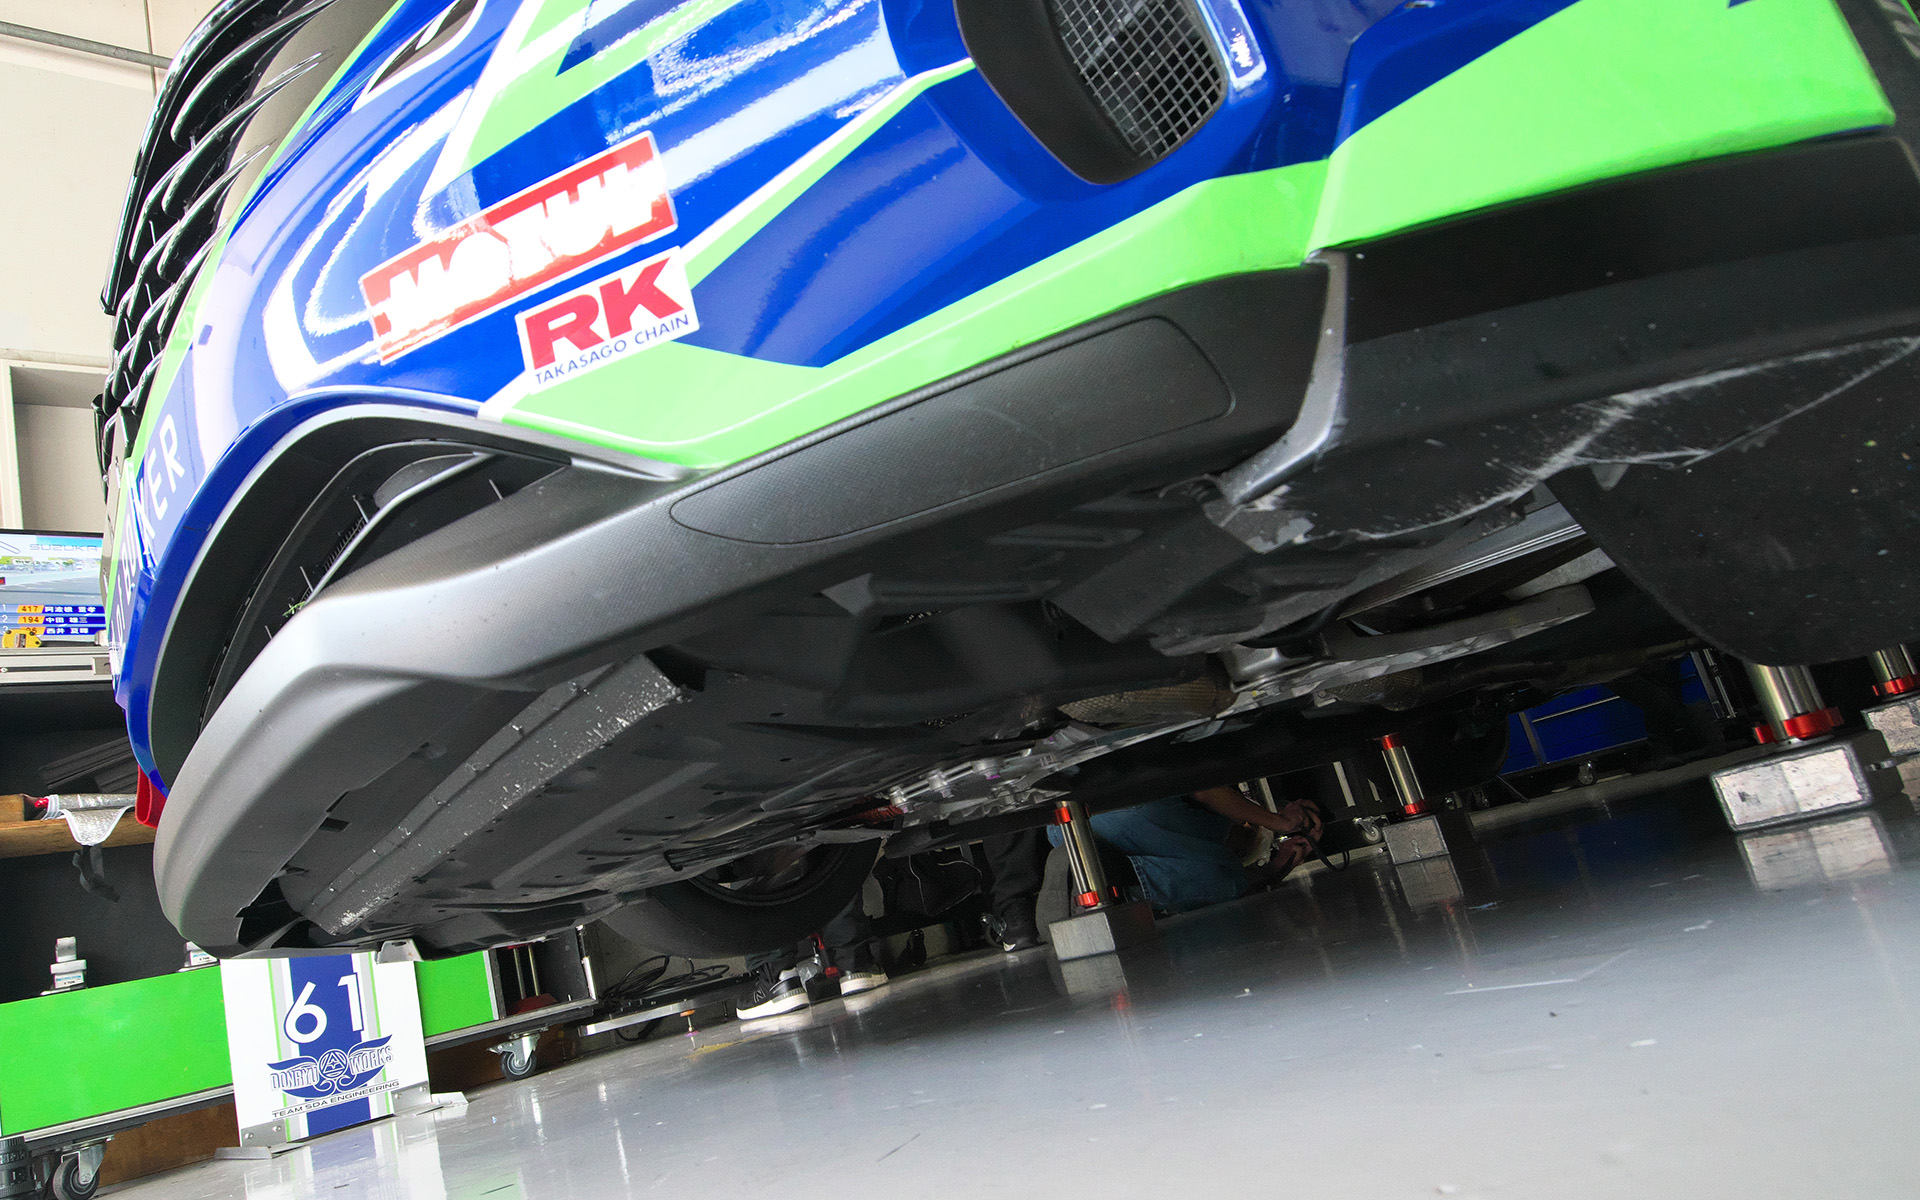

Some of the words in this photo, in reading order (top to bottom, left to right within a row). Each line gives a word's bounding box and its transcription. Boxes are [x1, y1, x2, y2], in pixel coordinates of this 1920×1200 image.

[525, 256, 685, 370] RK
[535, 337, 628, 386] TAKASAGO
[634, 313, 690, 346] CHAIN
[29, 543, 98, 552] SUZUKA
[283, 972, 364, 1044] 61
[270, 1065, 320, 1092] DONRYU
[348, 1045, 394, 1075] WORKS
[272, 1106, 303, 1118] TEAM
[304, 1100, 328, 1109] SDA
[330, 1080, 400, 1104] ENGINEERING
